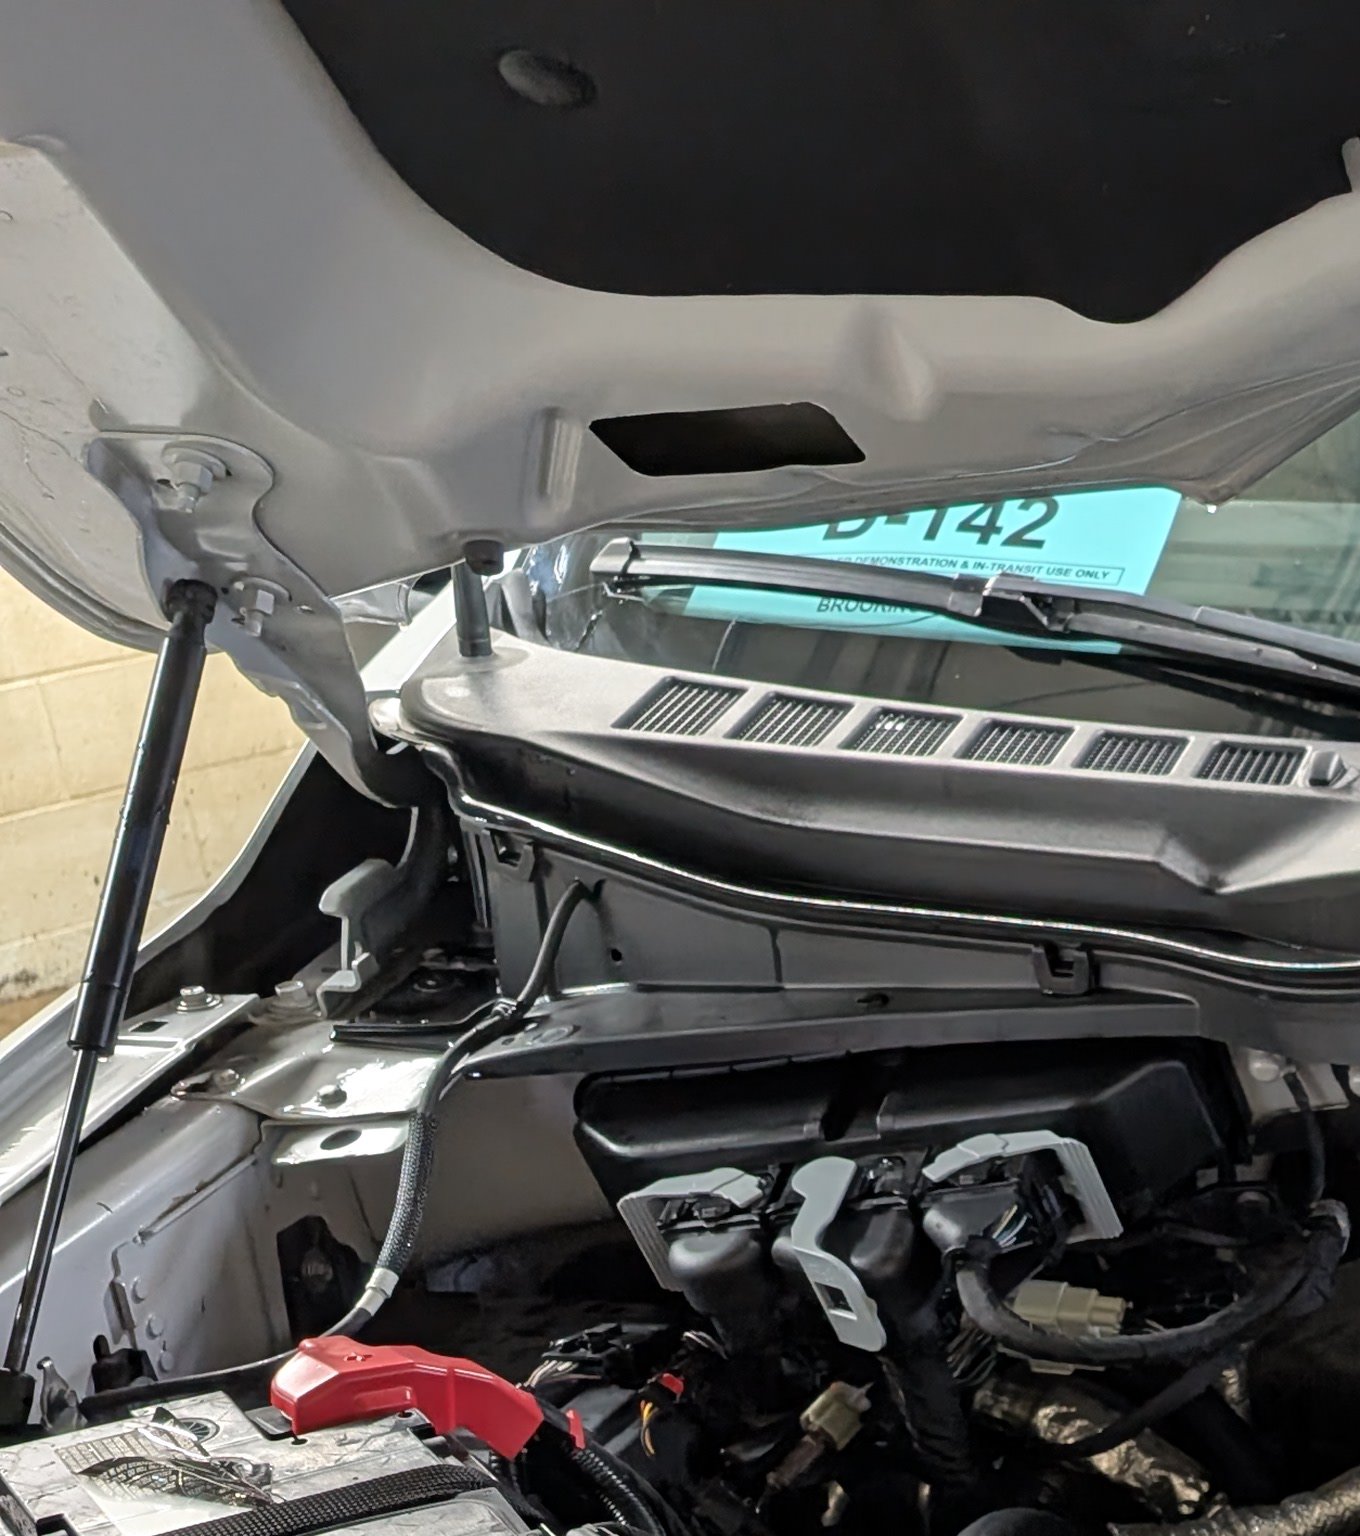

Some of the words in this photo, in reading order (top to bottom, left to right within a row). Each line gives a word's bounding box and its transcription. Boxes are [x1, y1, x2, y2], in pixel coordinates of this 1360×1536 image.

[855, 555, 958, 569] DEMONSTRATION
[960, 560, 970, 569] &
[972, 562, 1044, 576] IN-TRANSIT
[1045, 567, 1073, 579] USE
[1075, 569, 1111, 580] ONLY
[816, 596, 922, 613] BROOK
